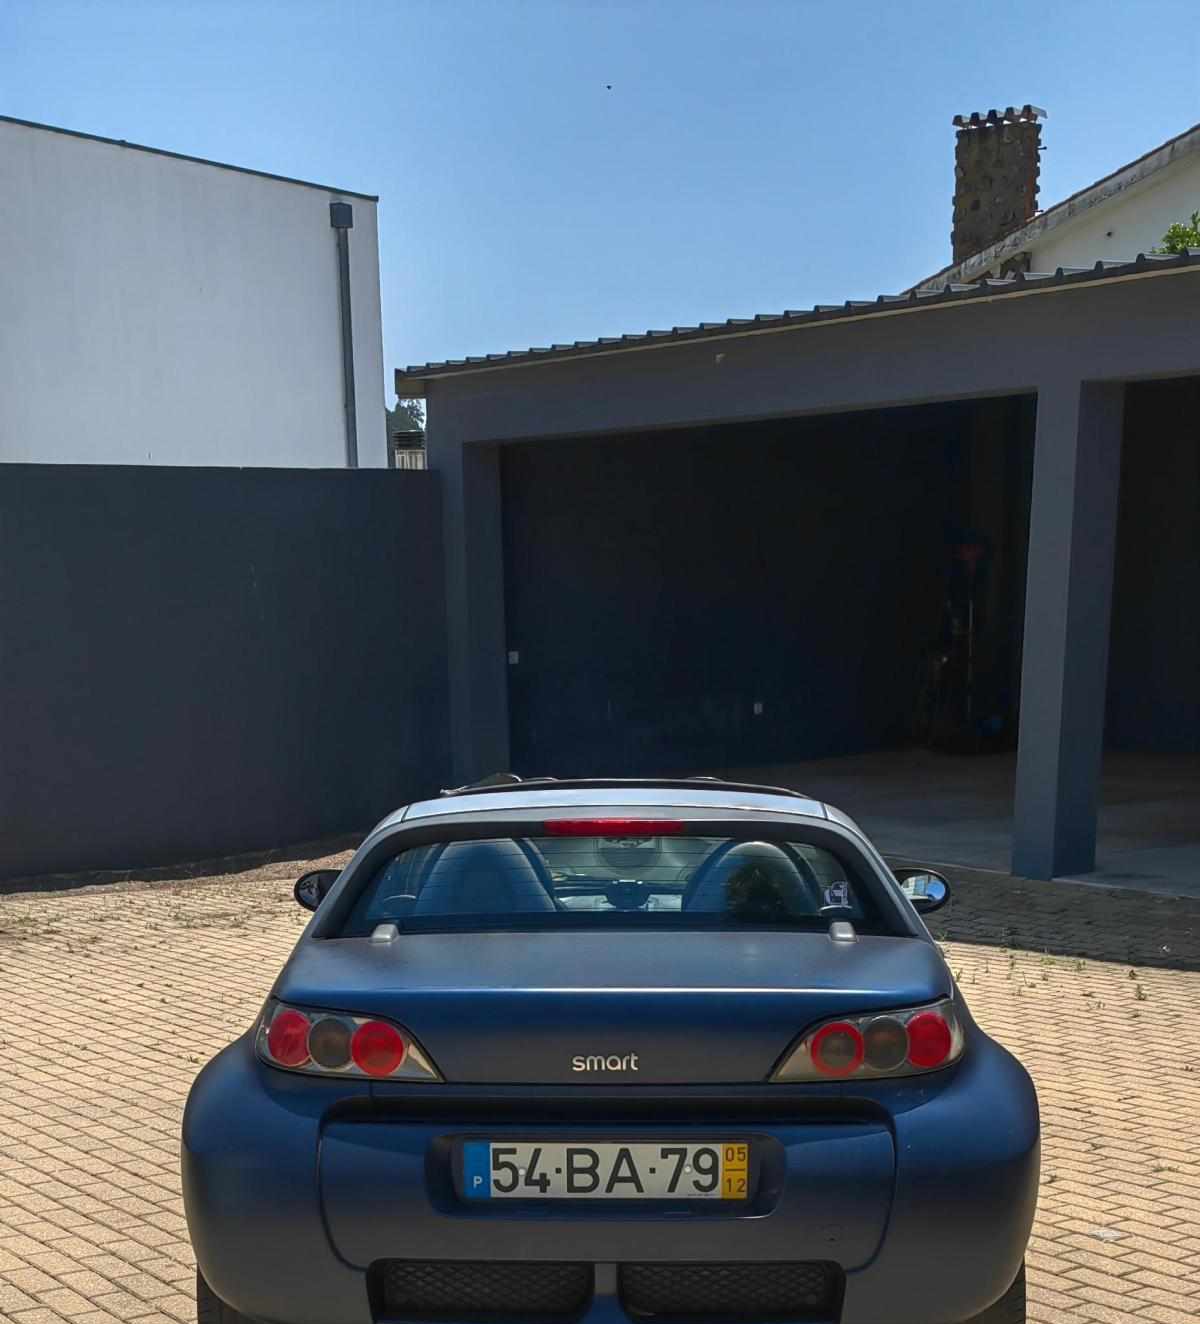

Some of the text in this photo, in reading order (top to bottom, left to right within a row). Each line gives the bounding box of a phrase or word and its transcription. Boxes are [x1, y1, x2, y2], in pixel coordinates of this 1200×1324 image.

[572, 1052, 639, 1072] smart
[725, 1147, 746, 1162] 05
[473, 1176, 483, 1187] P
[726, 1178, 746, 1193] 12
